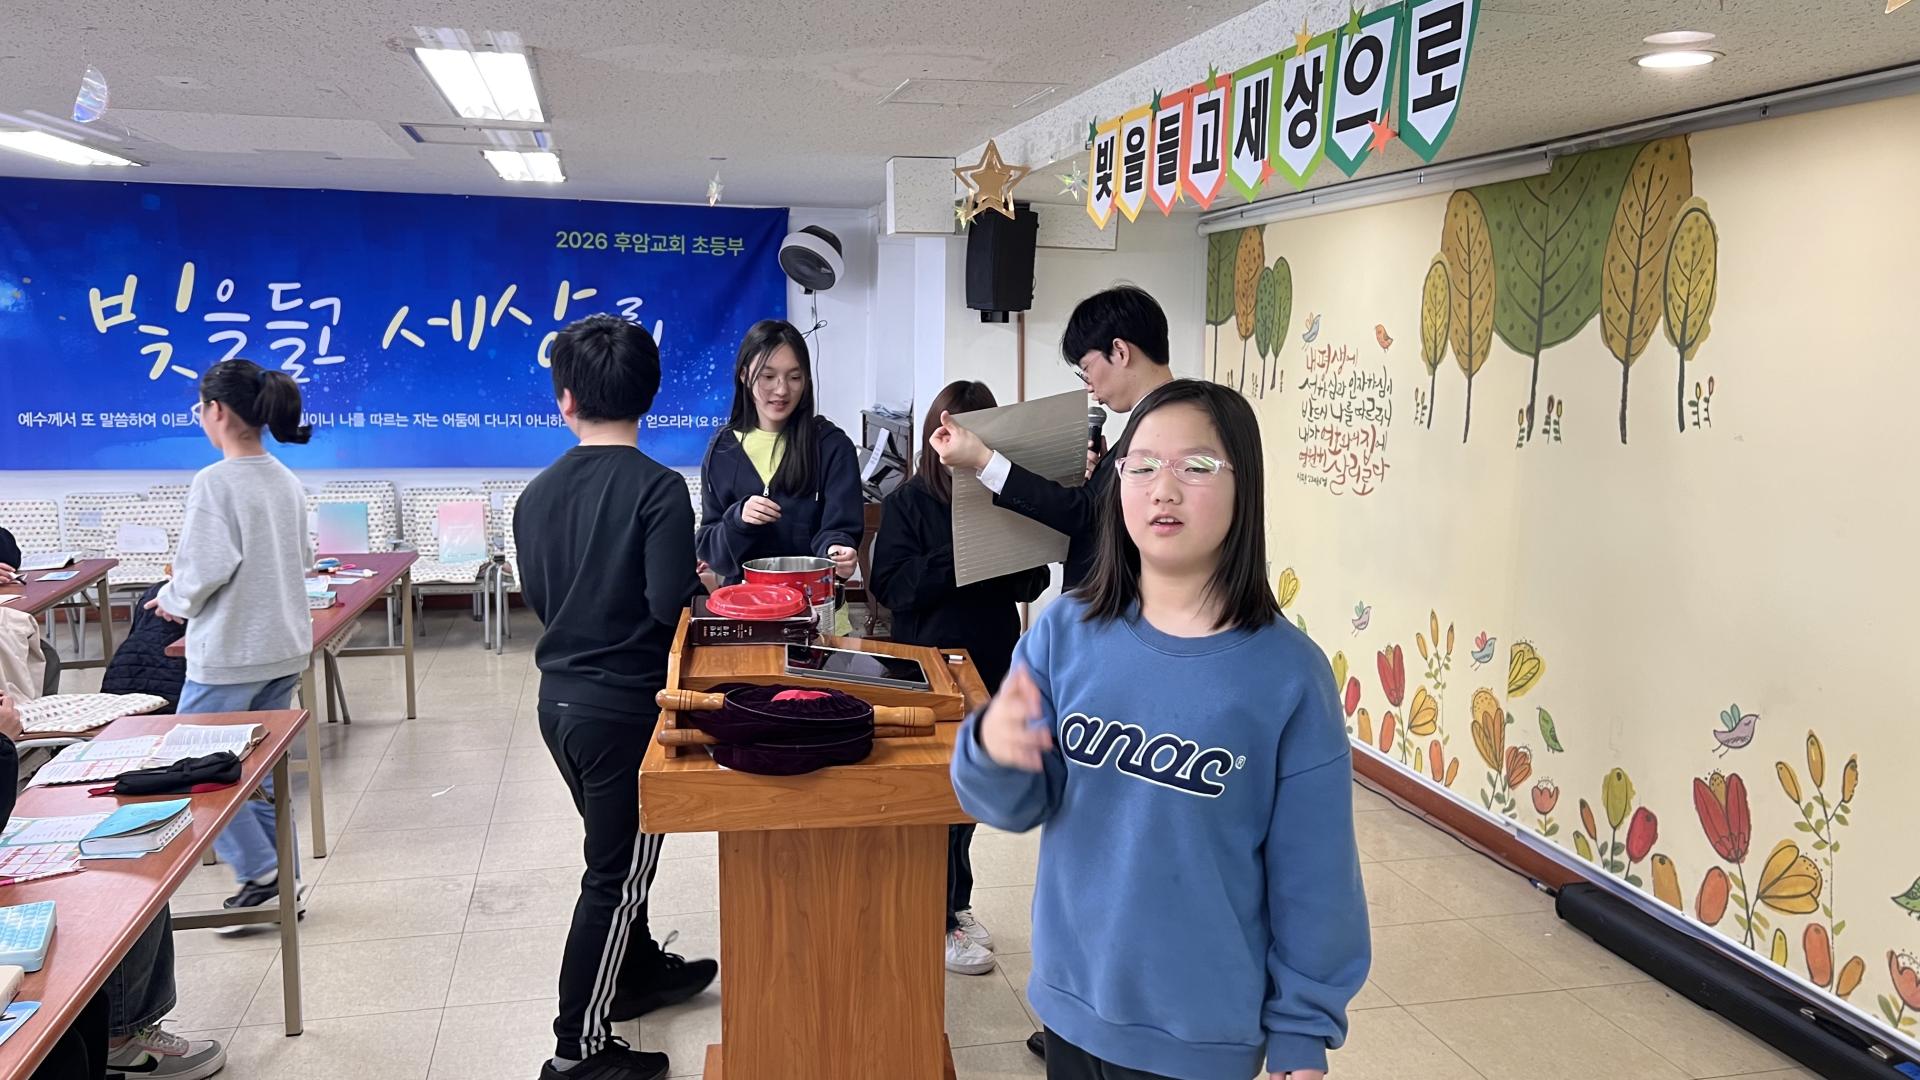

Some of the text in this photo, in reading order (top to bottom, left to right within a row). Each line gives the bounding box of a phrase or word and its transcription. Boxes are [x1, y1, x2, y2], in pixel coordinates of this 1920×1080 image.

[556, 231, 745, 257] 2026 후암교회 초등부
[18, 411, 76, 428] 예수께서
[81, 412, 96, 427] 또
[100, 411, 157, 428] 말씀하여
[340, 412, 366, 427] 나를
[370, 412, 409, 428] 따르는
[413, 412, 438, 428] 자는
[443, 412, 480, 428] 어둠에
[485, 413, 521, 428] 다니지
[526, 414, 568, 428] 아니하
[646, 414, 692, 429] 얻으리라
[712, 416, 731, 428] 8:1
[1302, 397, 1392, 428] 반드시 나를 따르리니
[1299, 424, 1320, 443] 내가
[1060, 712, 1234, 798] anac
